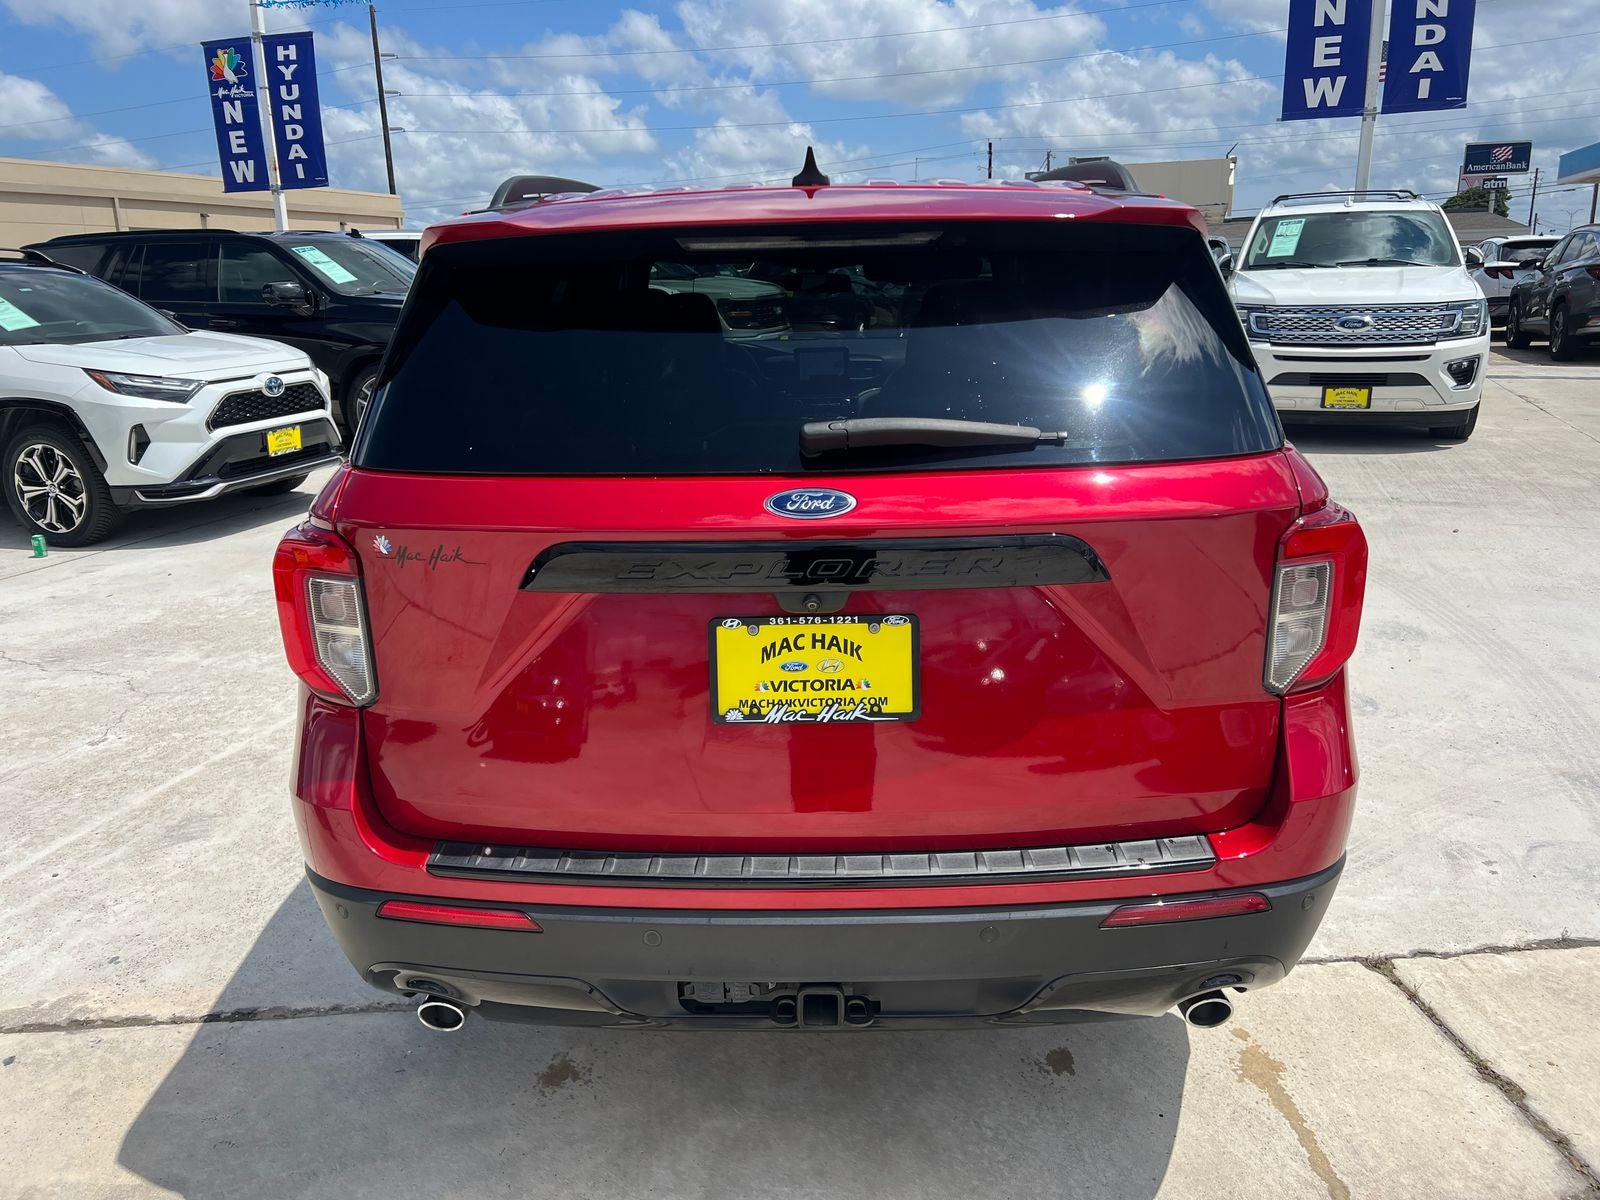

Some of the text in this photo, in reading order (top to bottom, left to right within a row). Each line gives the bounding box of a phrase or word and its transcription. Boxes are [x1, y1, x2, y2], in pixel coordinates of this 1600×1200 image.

[1303, 0, 1347, 108] NEW
[276, 44, 308, 179] HYUNDAI
[223, 100, 254, 183] NEW
[1467, 161, 1527, 171] AmericanBank
[1484, 179, 1506, 189] atm
[786, 492, 836, 510] Ford
[394, 544, 464, 571] Mac Haik
[615, 557, 1005, 580] EXPLORER
[769, 615, 859, 625] 361-576-1221
[761, 633, 864, 664] MAC HAIK
[769, 678, 856, 693] VICTORIA
[764, 702, 870, 724] Mac Haik
